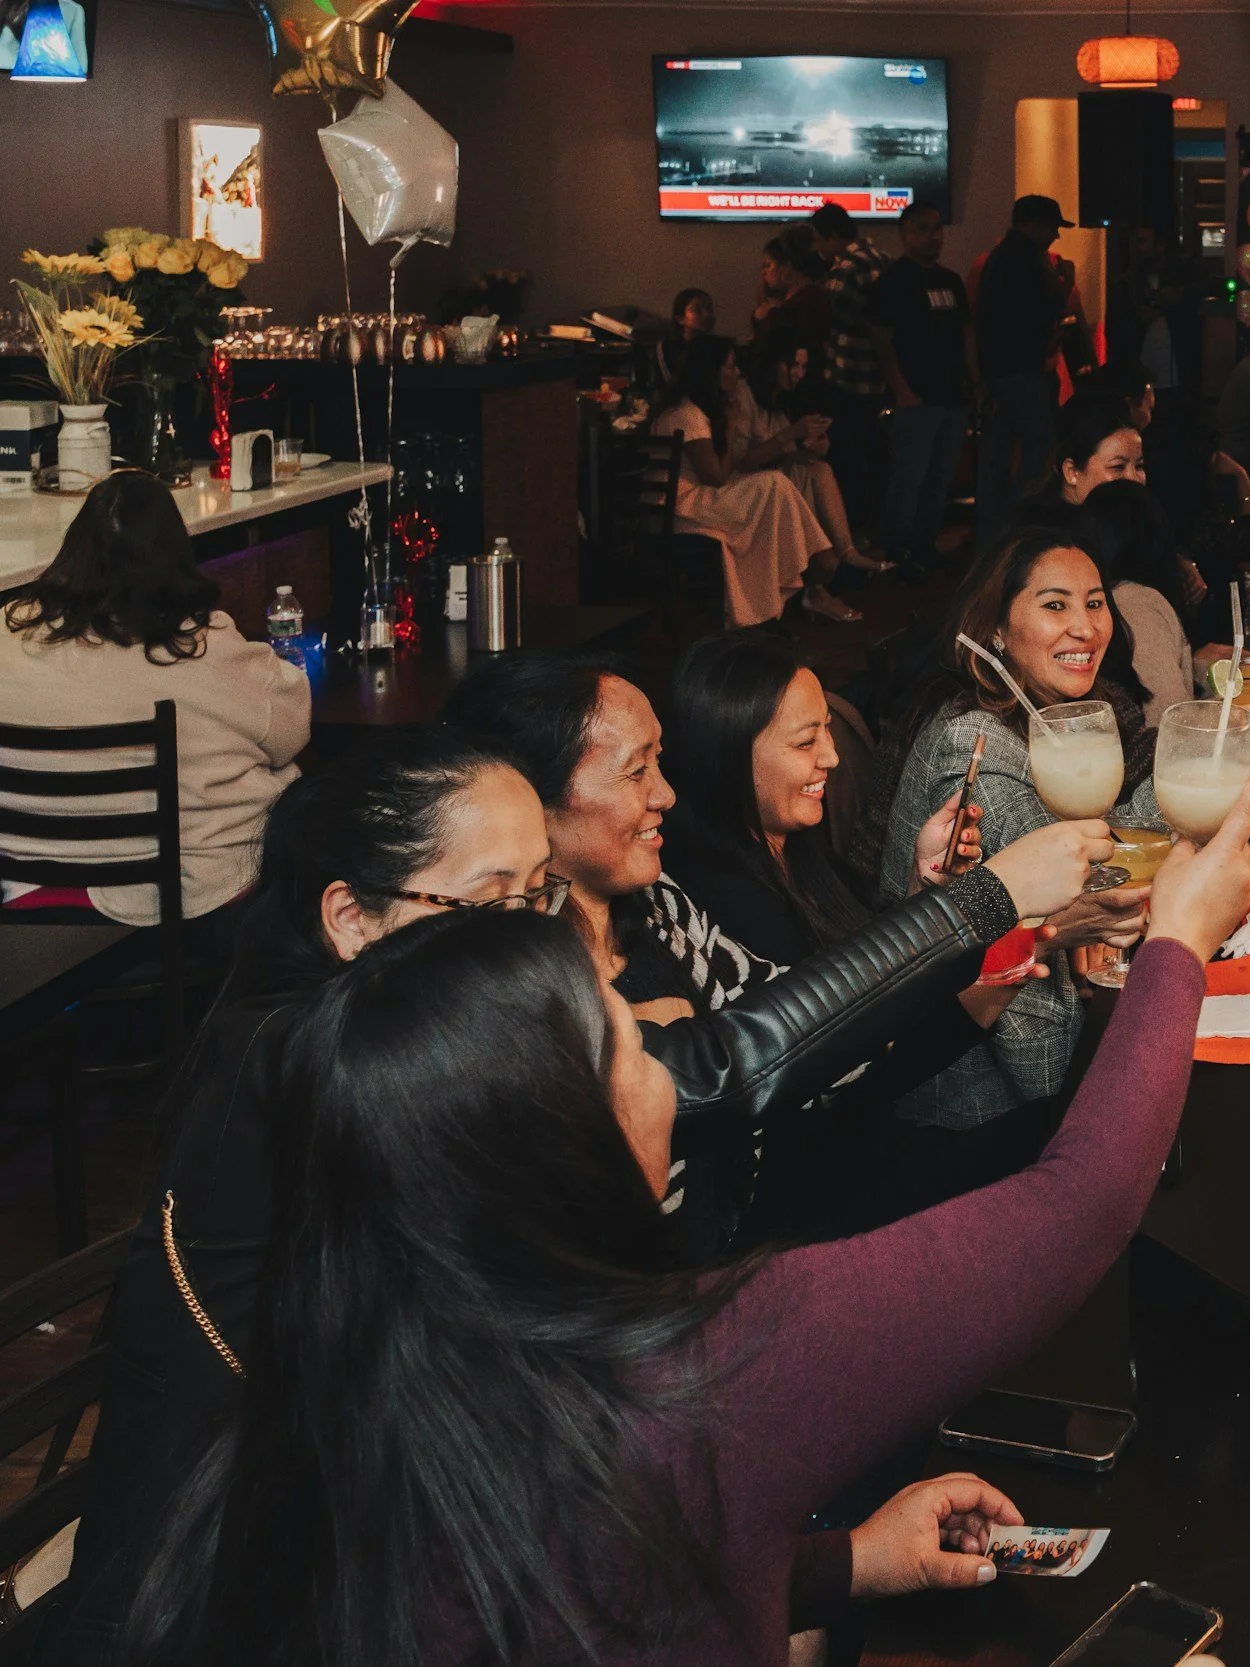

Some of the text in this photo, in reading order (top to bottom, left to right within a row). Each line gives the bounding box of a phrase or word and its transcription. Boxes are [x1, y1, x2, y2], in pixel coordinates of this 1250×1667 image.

[708, 195, 824, 207] WE'LL BE RIGHT BACK
[875, 196, 909, 207] NOW
